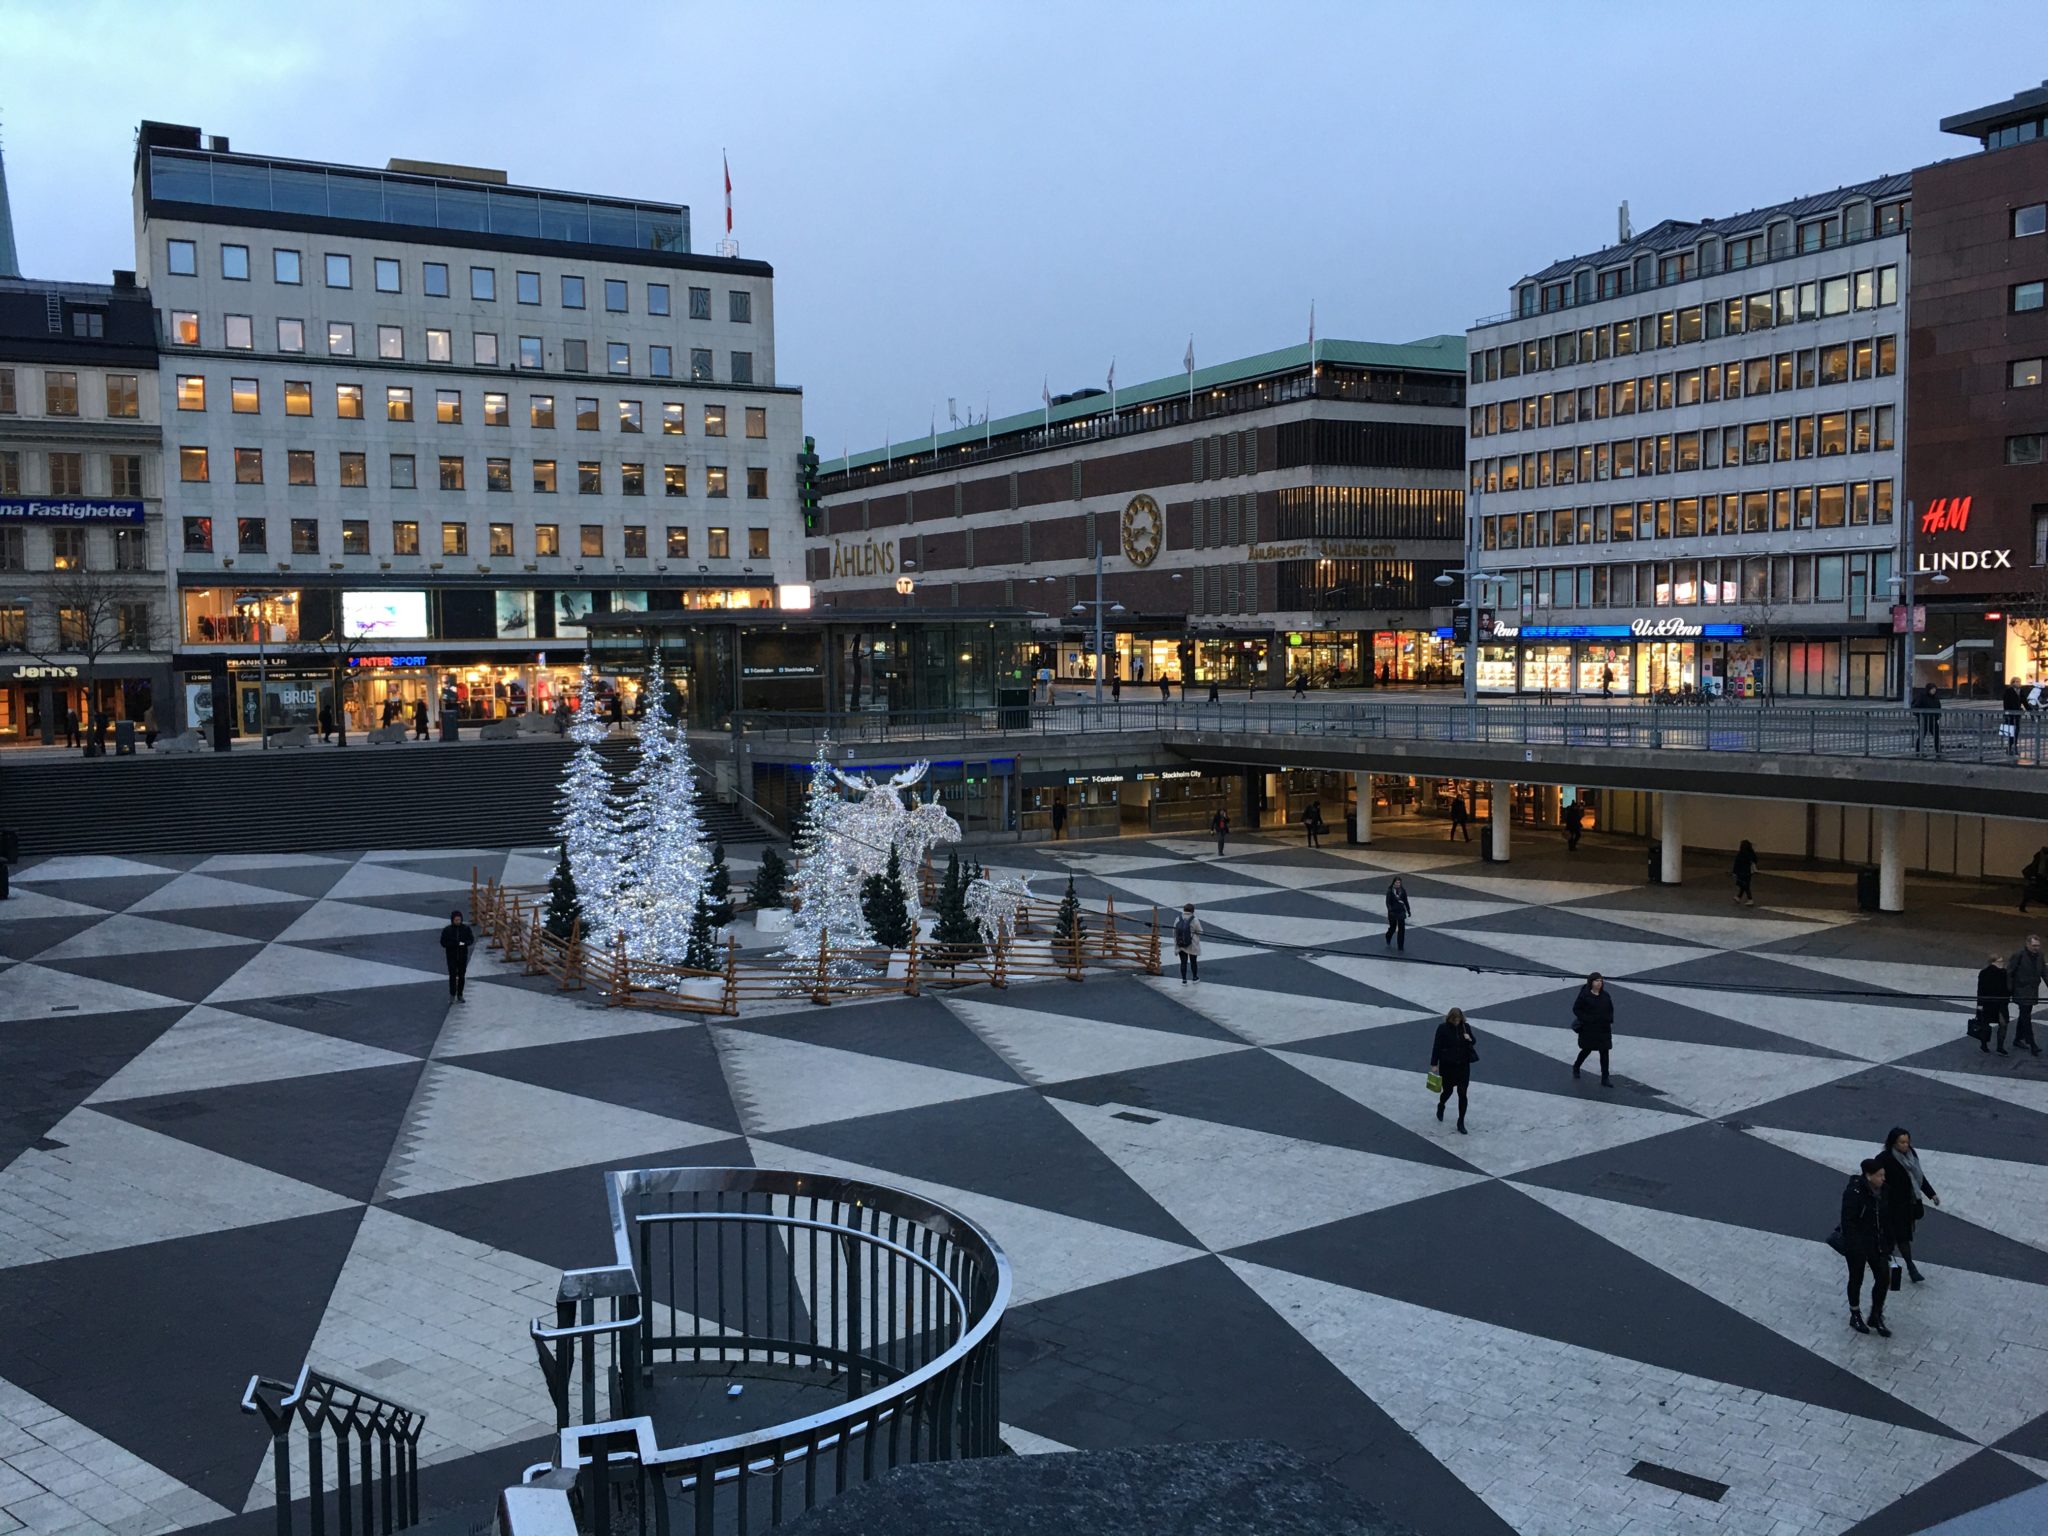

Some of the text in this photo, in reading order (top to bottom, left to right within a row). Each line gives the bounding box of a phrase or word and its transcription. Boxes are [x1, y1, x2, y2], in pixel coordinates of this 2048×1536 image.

[28, 502, 136, 519] Fastigheter
[1922, 496, 1972, 533] H&M
[832, 537, 895, 577] ÅHLÉNS
[1371, 543, 1397, 557] CITY
[1919, 549, 2012, 571] LINDEX
[1631, 617, 1702, 637] Ur&Penn
[360, 656, 427, 667] INTERSPORT
[1092, 775, 1123, 783] T-Centralen
[1162, 771, 1190, 779] Stockholm
[1190, 770, 1201, 778] City
[968, 783, 988, 798] SL
